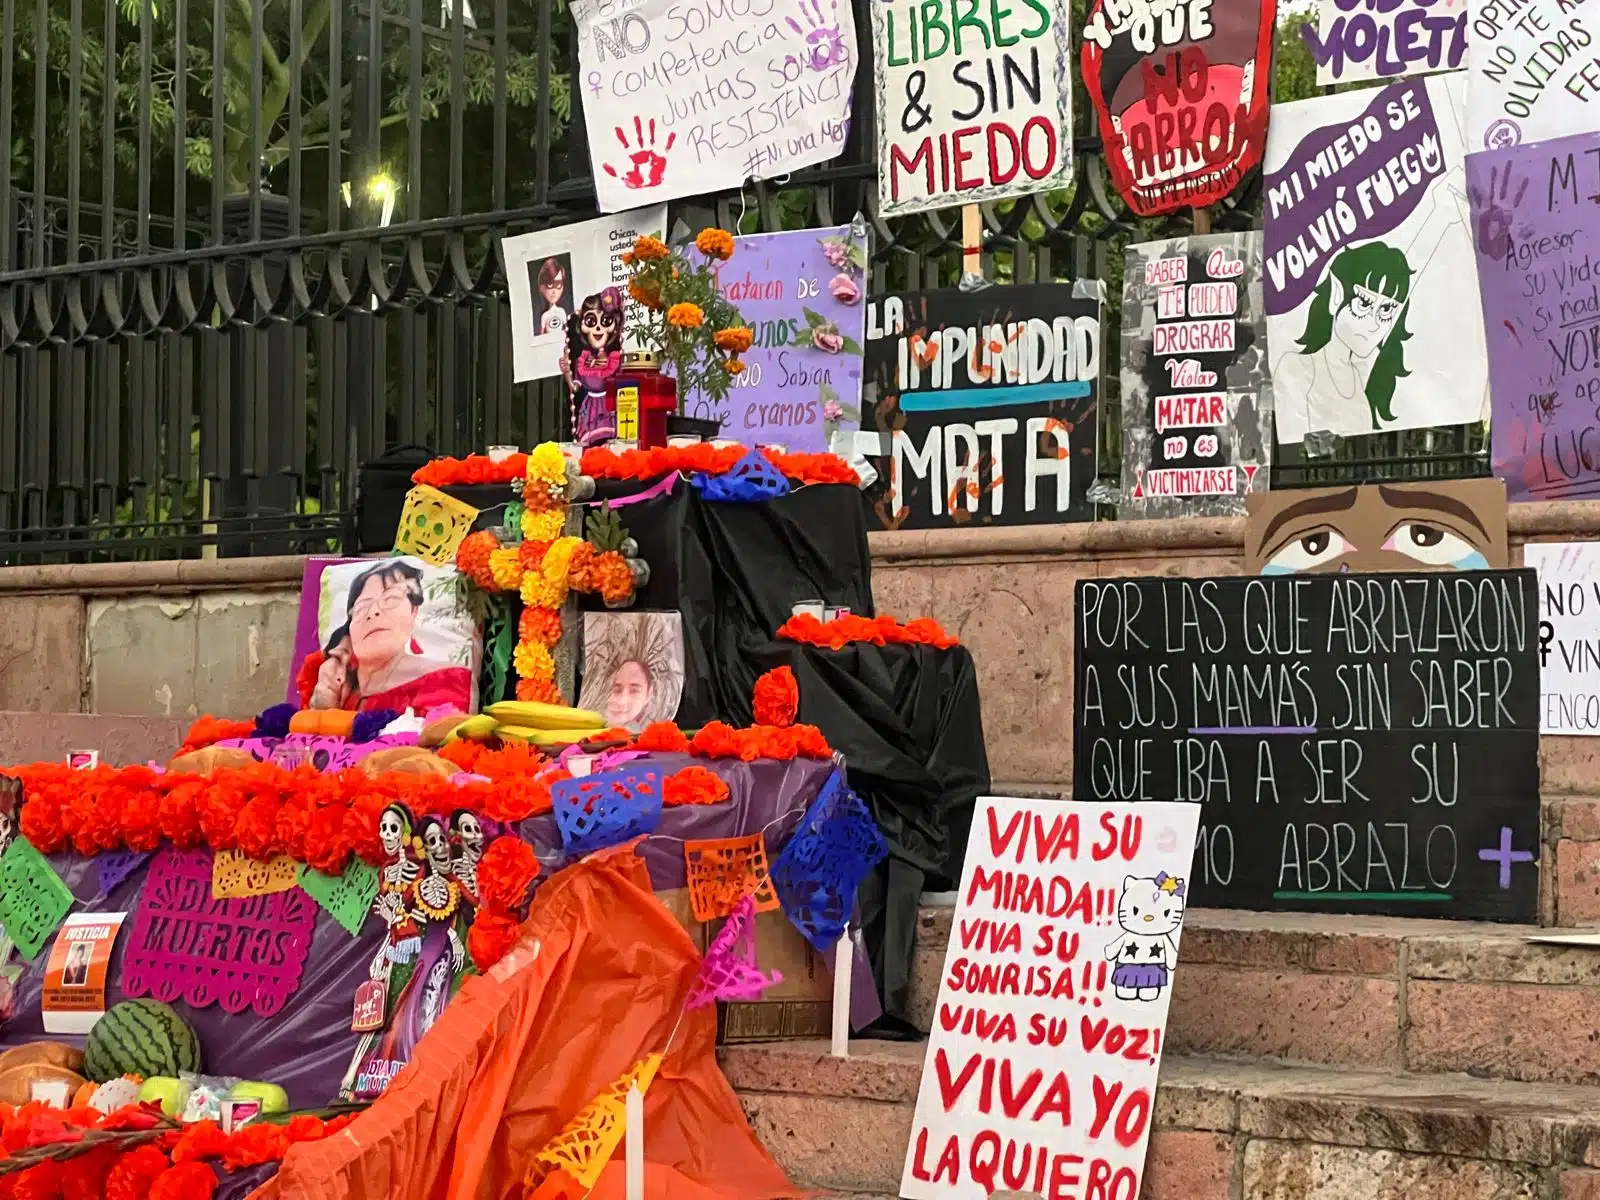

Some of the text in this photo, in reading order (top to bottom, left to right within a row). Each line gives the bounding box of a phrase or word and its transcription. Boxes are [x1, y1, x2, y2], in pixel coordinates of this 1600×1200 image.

[592, 13, 650, 62] NO
[887, 0, 1051, 66] LIBRES
[1131, 0, 1213, 53] QUE
[1482, 6, 1550, 83] NO TE
[901, 46, 1041, 134] & SIN
[1142, 46, 1209, 115] NO
[1504, 18, 1591, 118] OLVIDAS
[890, 116, 1057, 202] MIEDO
[1268, 89, 1421, 220] MI MIEDO SE
[608, 228, 638, 241] Chicas,
[1266, 186, 1357, 293] VOLVIÓ
[1146, 250, 1242, 284] SABER Que
[866, 296, 904, 340] LA
[1159, 284, 1236, 316] TE PUEDEN
[898, 315, 1100, 391] IMPUNIDAD
[1155, 322, 1233, 353] DROGRAR
[1166, 360, 1216, 386] Violar
[1158, 396, 1224, 427] MATAR
[890, 417, 1071, 518] MATA
[1167, 439, 1213, 455] no es
[1082, 576, 1525, 654] POR LAS QUE ABRAZARON
[1546, 582, 1585, 616] NO
[1084, 657, 1516, 730] A SUS MAMÁS SIN SABER
[1540, 693, 1600, 730] ENGO
[1091, 738, 1459, 806] QUE IBA A SER SU
[987, 806, 1142, 864] VIVA SU
[1278, 821, 1457, 892] ABRAZO
[966, 865, 1115, 926] MIRADA!!
[64, 926, 111, 940] JUSTICIA
[143, 915, 292, 966] MUERTOS
[960, 918, 1079, 962] VIVA SU
[947, 957, 1107, 1008] SONRISA!!
[939, 1003, 1160, 1066] VIVA SU VOZ!
[934, 1047, 1149, 1148] VIVA YO
